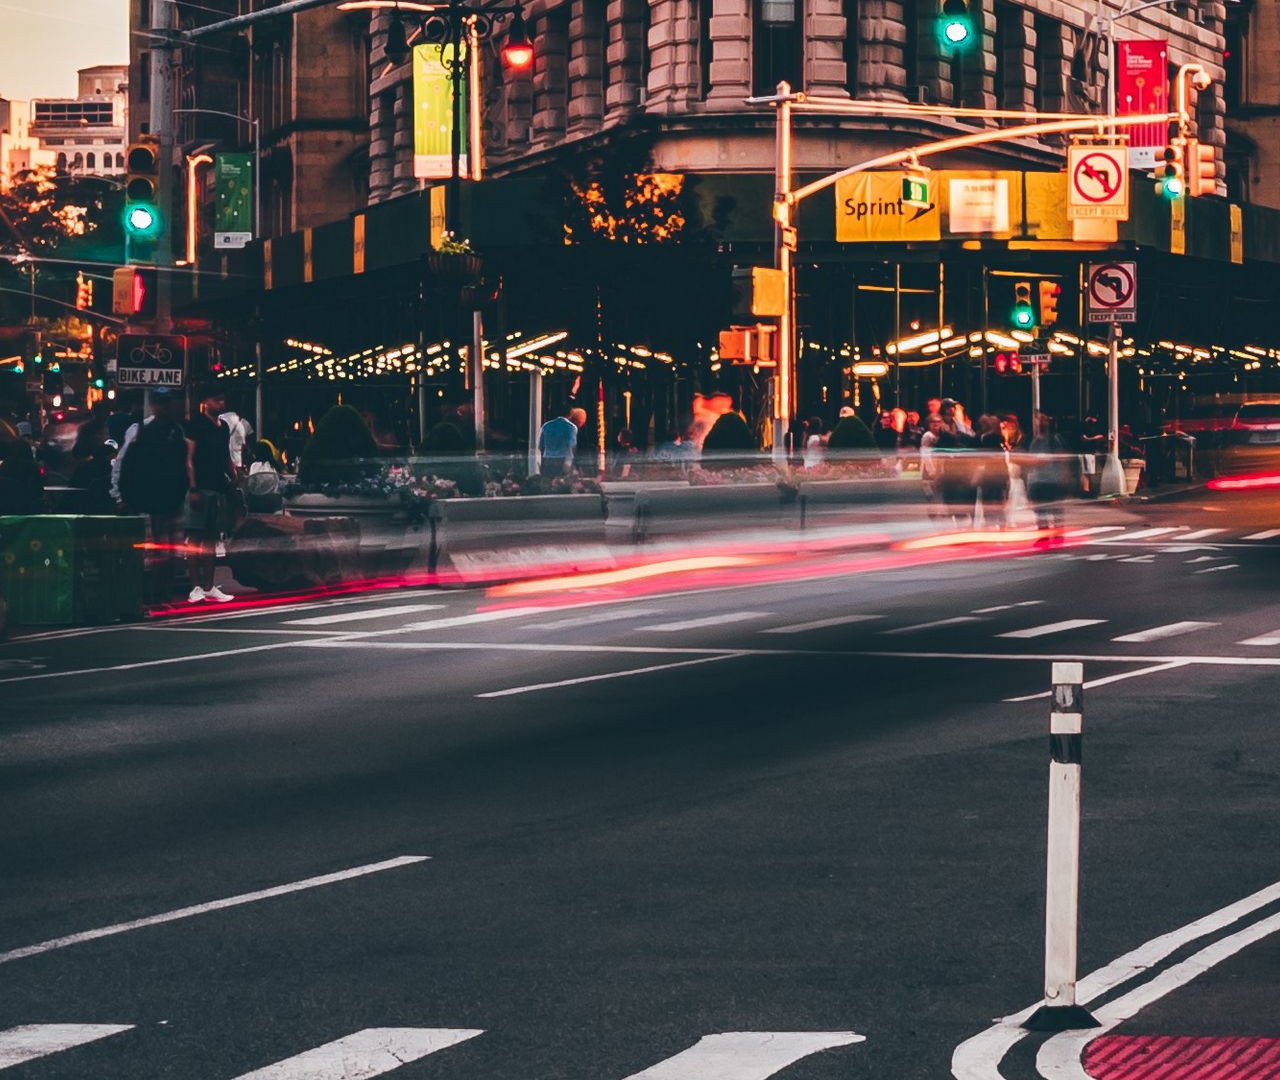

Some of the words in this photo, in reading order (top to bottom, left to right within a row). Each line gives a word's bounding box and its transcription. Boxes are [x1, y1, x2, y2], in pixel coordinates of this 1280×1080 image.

[845, 197, 904, 220] Sprint
[120, 369, 145, 383] BIKE
[150, 370, 180, 384] LANE
